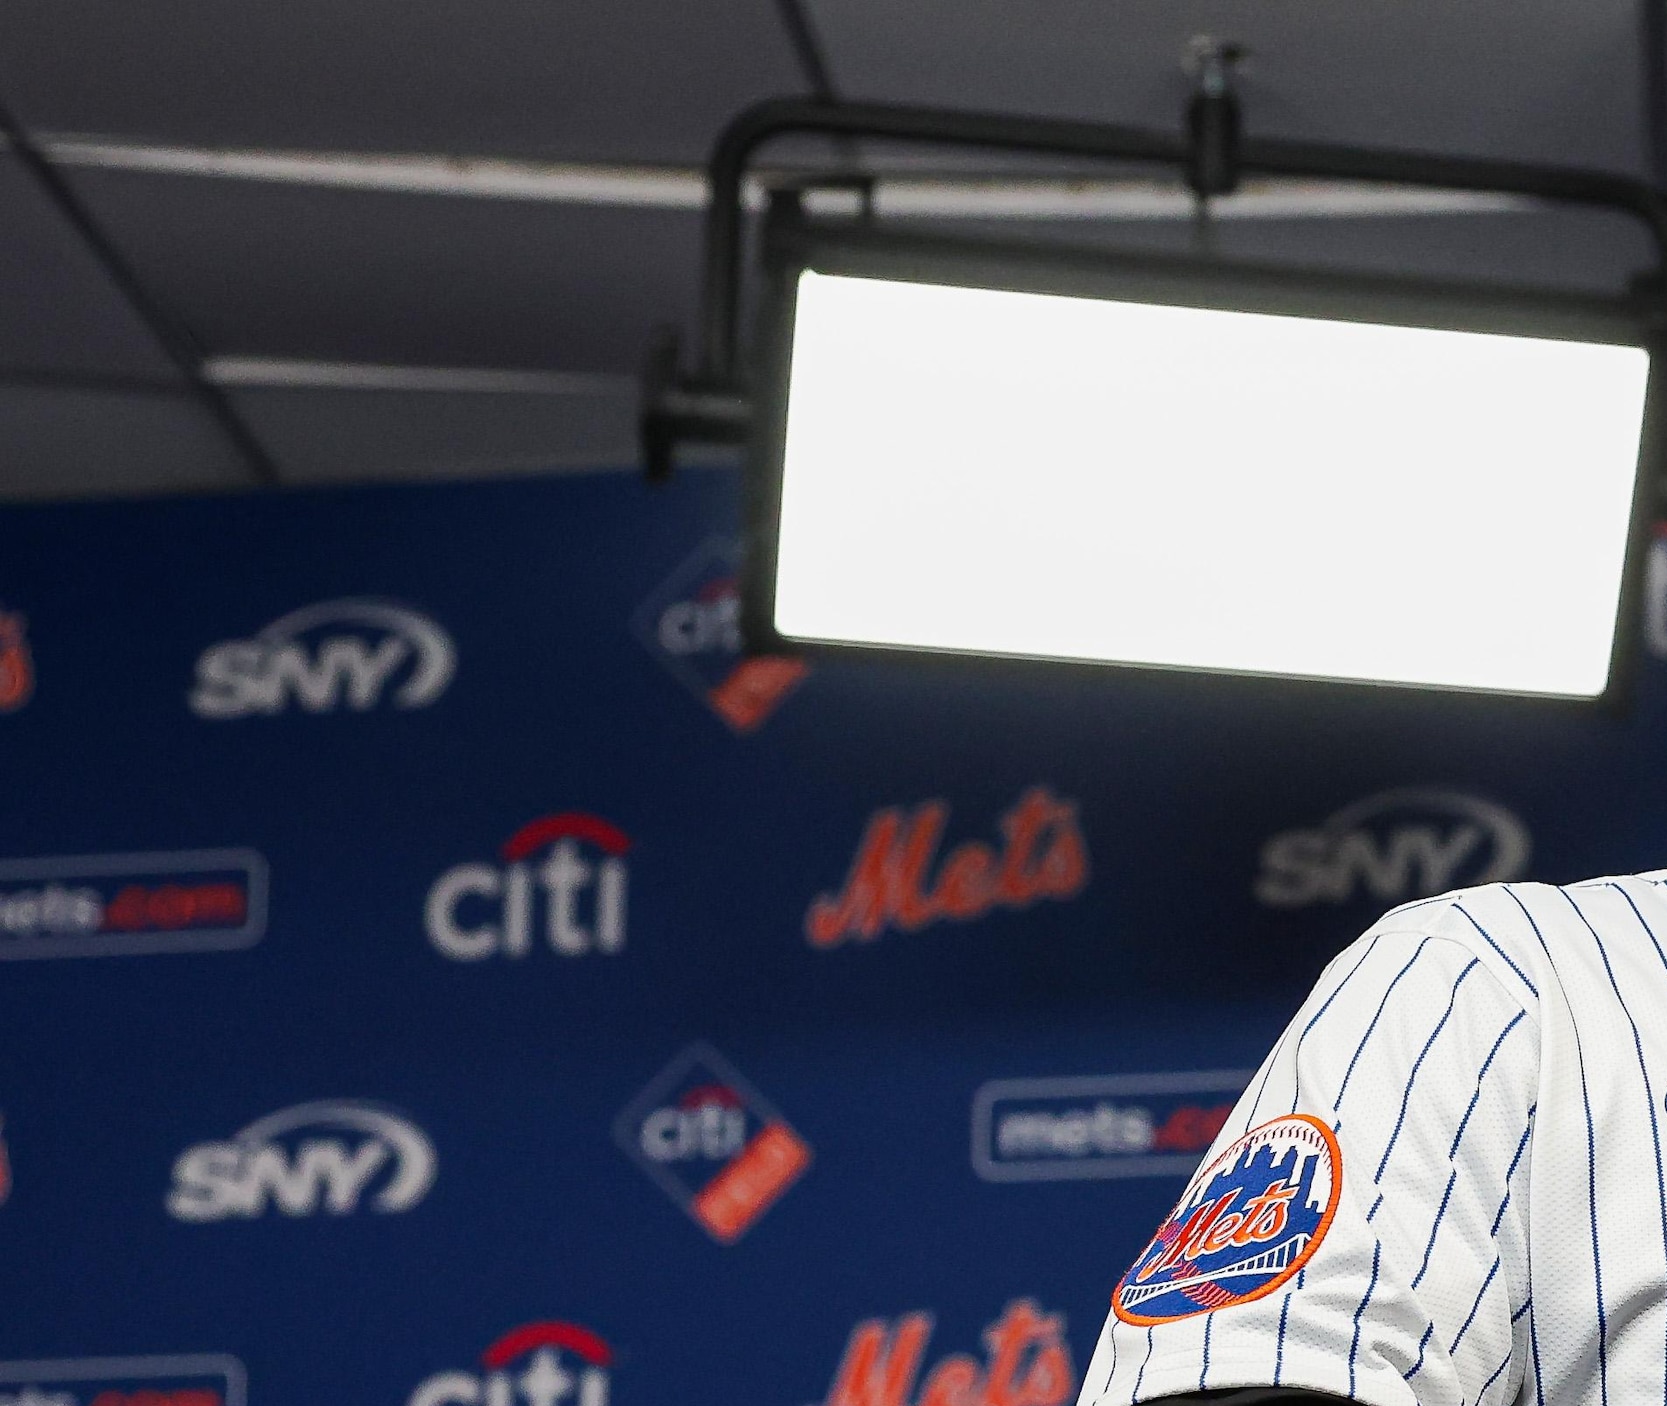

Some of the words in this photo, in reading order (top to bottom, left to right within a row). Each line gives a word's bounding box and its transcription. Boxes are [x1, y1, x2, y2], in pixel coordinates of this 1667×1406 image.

[190, 638, 405, 717] SNY
[422, 836, 628, 962] citi
[804, 787, 1087, 948] Mets
[1252, 826, 1482, 906] SNY
[166, 1141, 383, 1222] SNY
[1136, 1178, 1300, 1283] Mets
